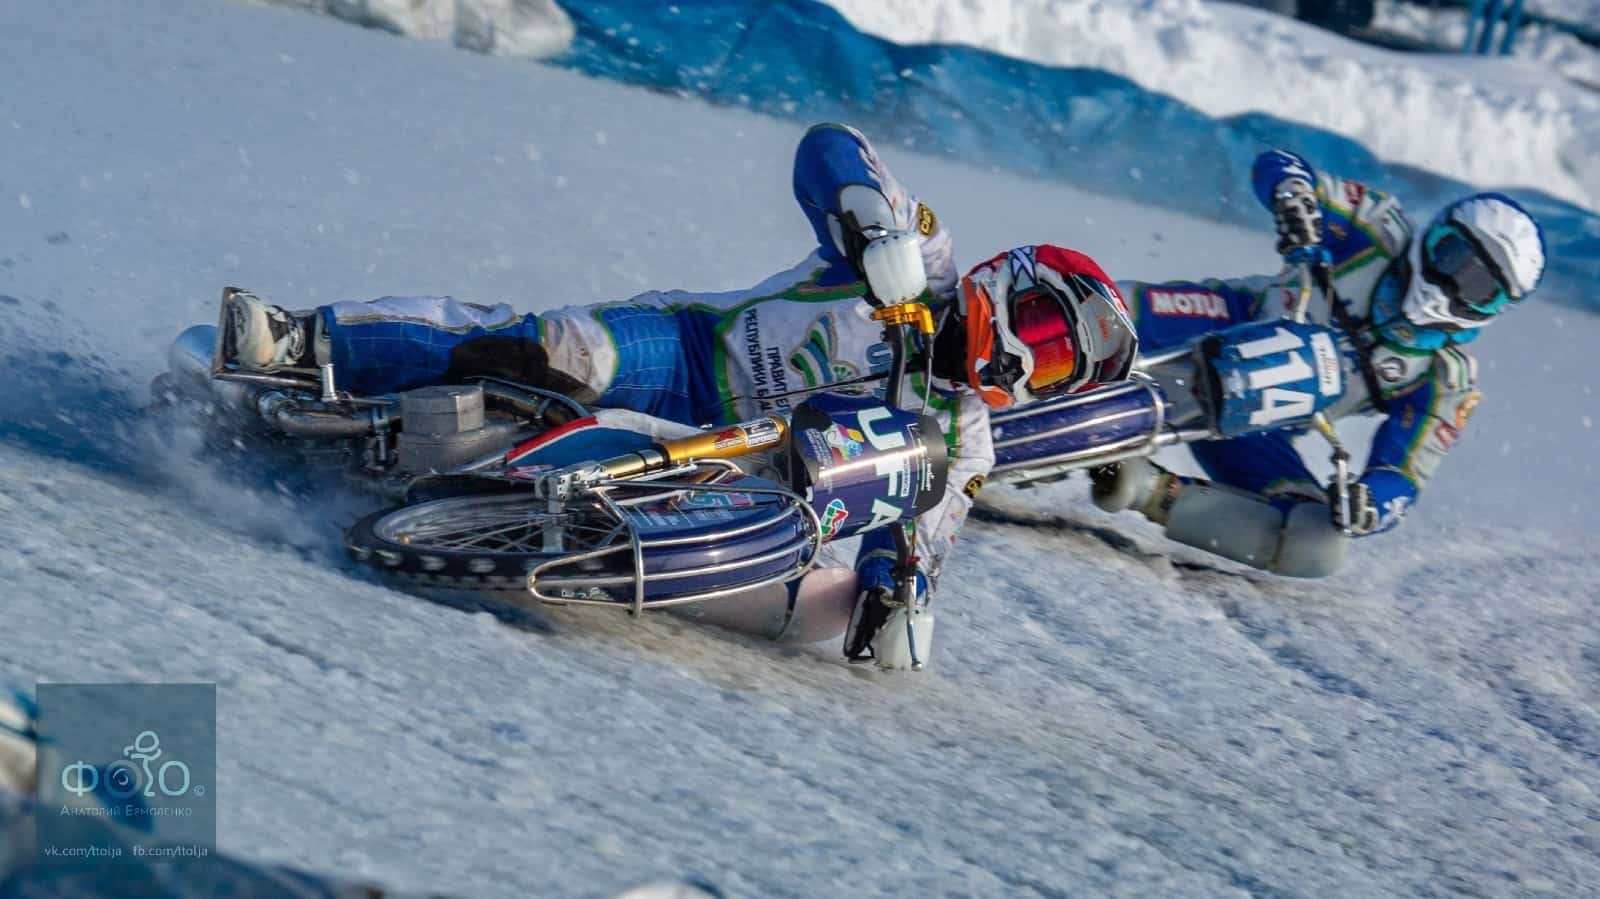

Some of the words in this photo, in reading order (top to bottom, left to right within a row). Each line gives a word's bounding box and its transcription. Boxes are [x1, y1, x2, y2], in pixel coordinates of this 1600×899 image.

[744, 308, 767, 386] РЕСПУБЛИКИ
[1237, 327, 1315, 425] 114
[856, 406, 907, 535] UFA
